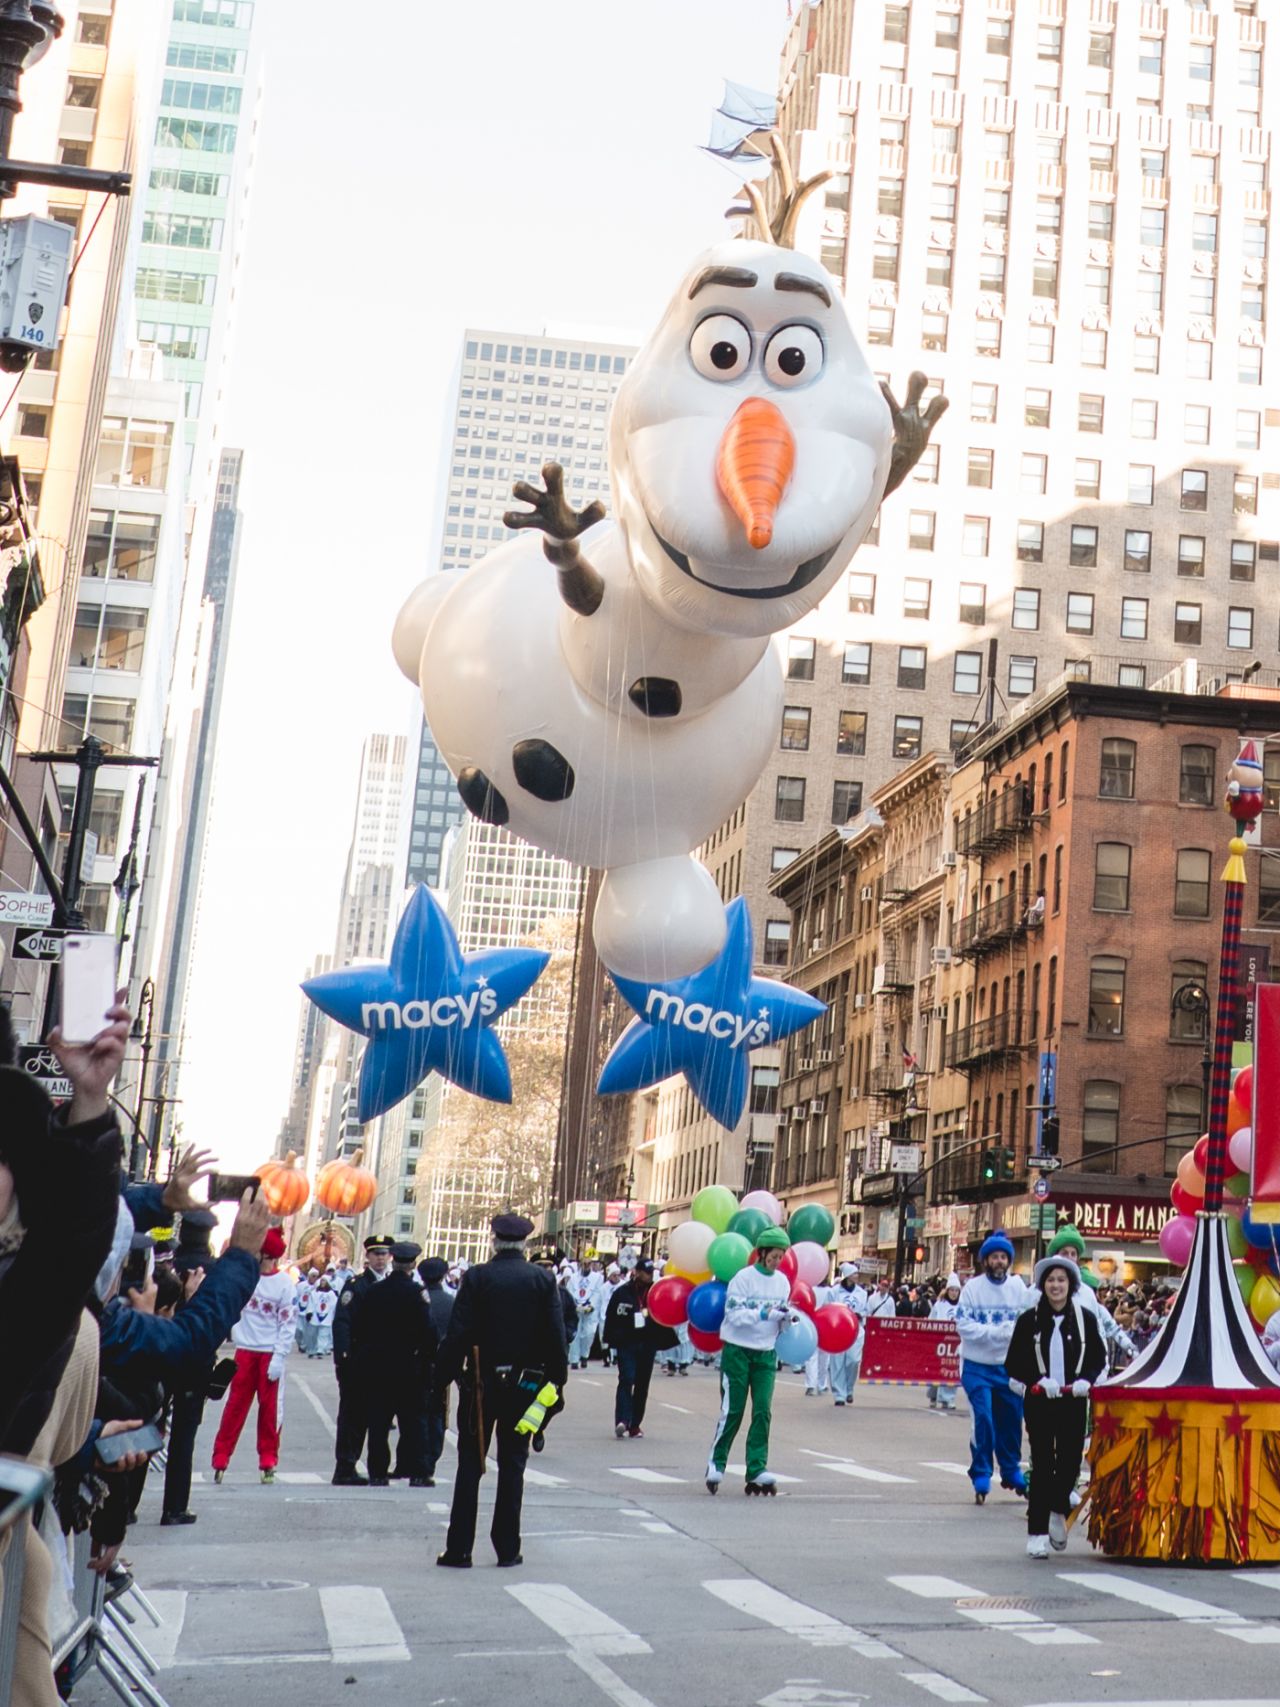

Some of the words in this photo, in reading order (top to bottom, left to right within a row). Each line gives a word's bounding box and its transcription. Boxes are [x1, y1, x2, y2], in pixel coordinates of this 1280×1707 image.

[21, 325, 44, 342] 140
[28, 938, 56, 951] ONE
[1248, 957, 1256, 982] LOVE
[1074, 1202, 1111, 1229] PRET
[1115, 1204, 1126, 1229] A
